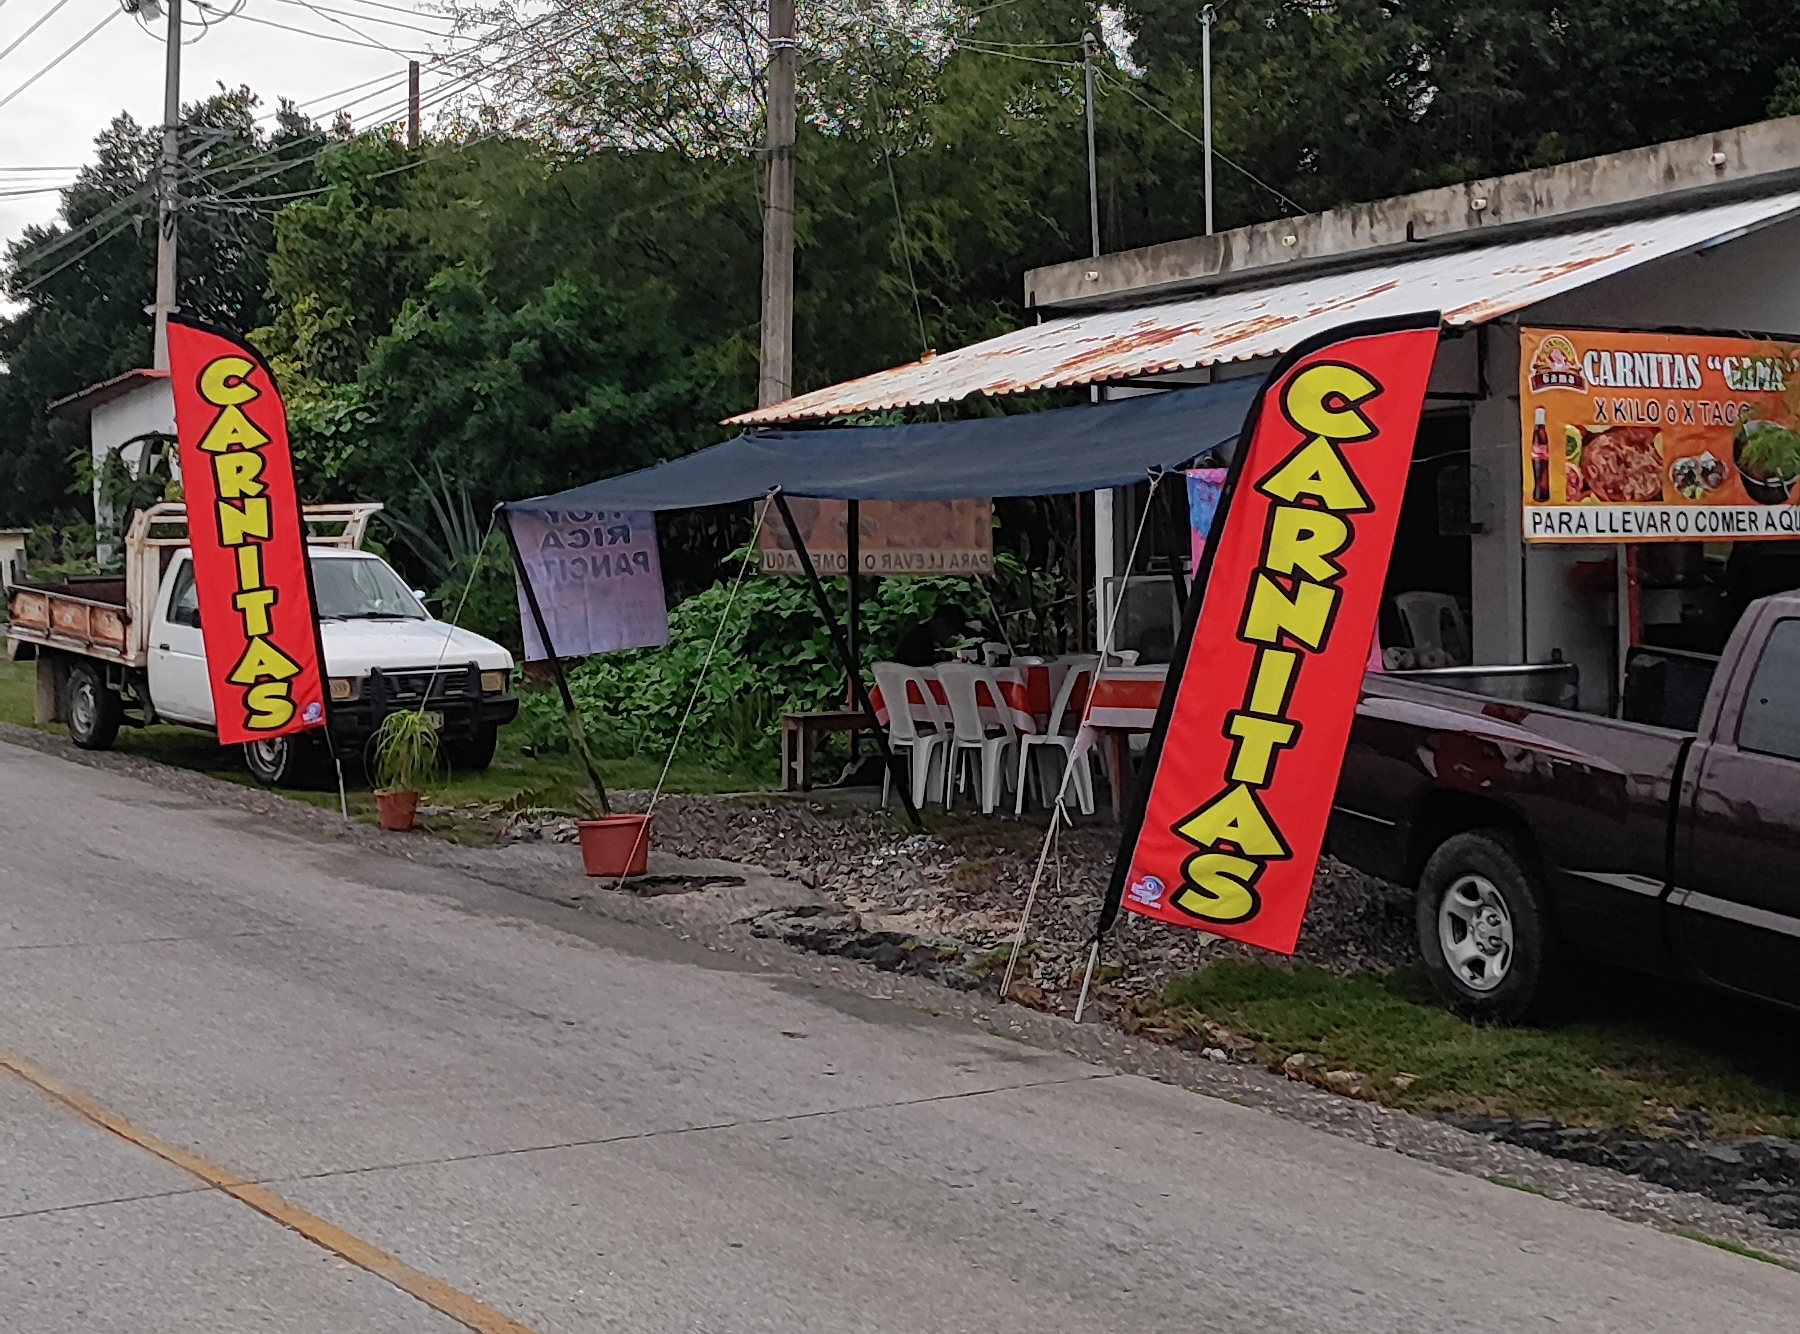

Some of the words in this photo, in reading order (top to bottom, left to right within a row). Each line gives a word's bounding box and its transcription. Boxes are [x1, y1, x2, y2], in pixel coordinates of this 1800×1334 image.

[1582, 349, 1702, 390] CARNITAS
[1594, 398, 1608, 422] X
[1612, 398, 1660, 423] KILO
[1682, 400, 1694, 424] X
[1532, 510, 1588, 535] PARA
[1595, 510, 1672, 534] LLEVAR
[1676, 510, 1690, 534] O
[1694, 510, 1759, 533] COMER
[199, 357, 301, 730] CARNITAS
[1176, 364, 1379, 921] CARNITAS
